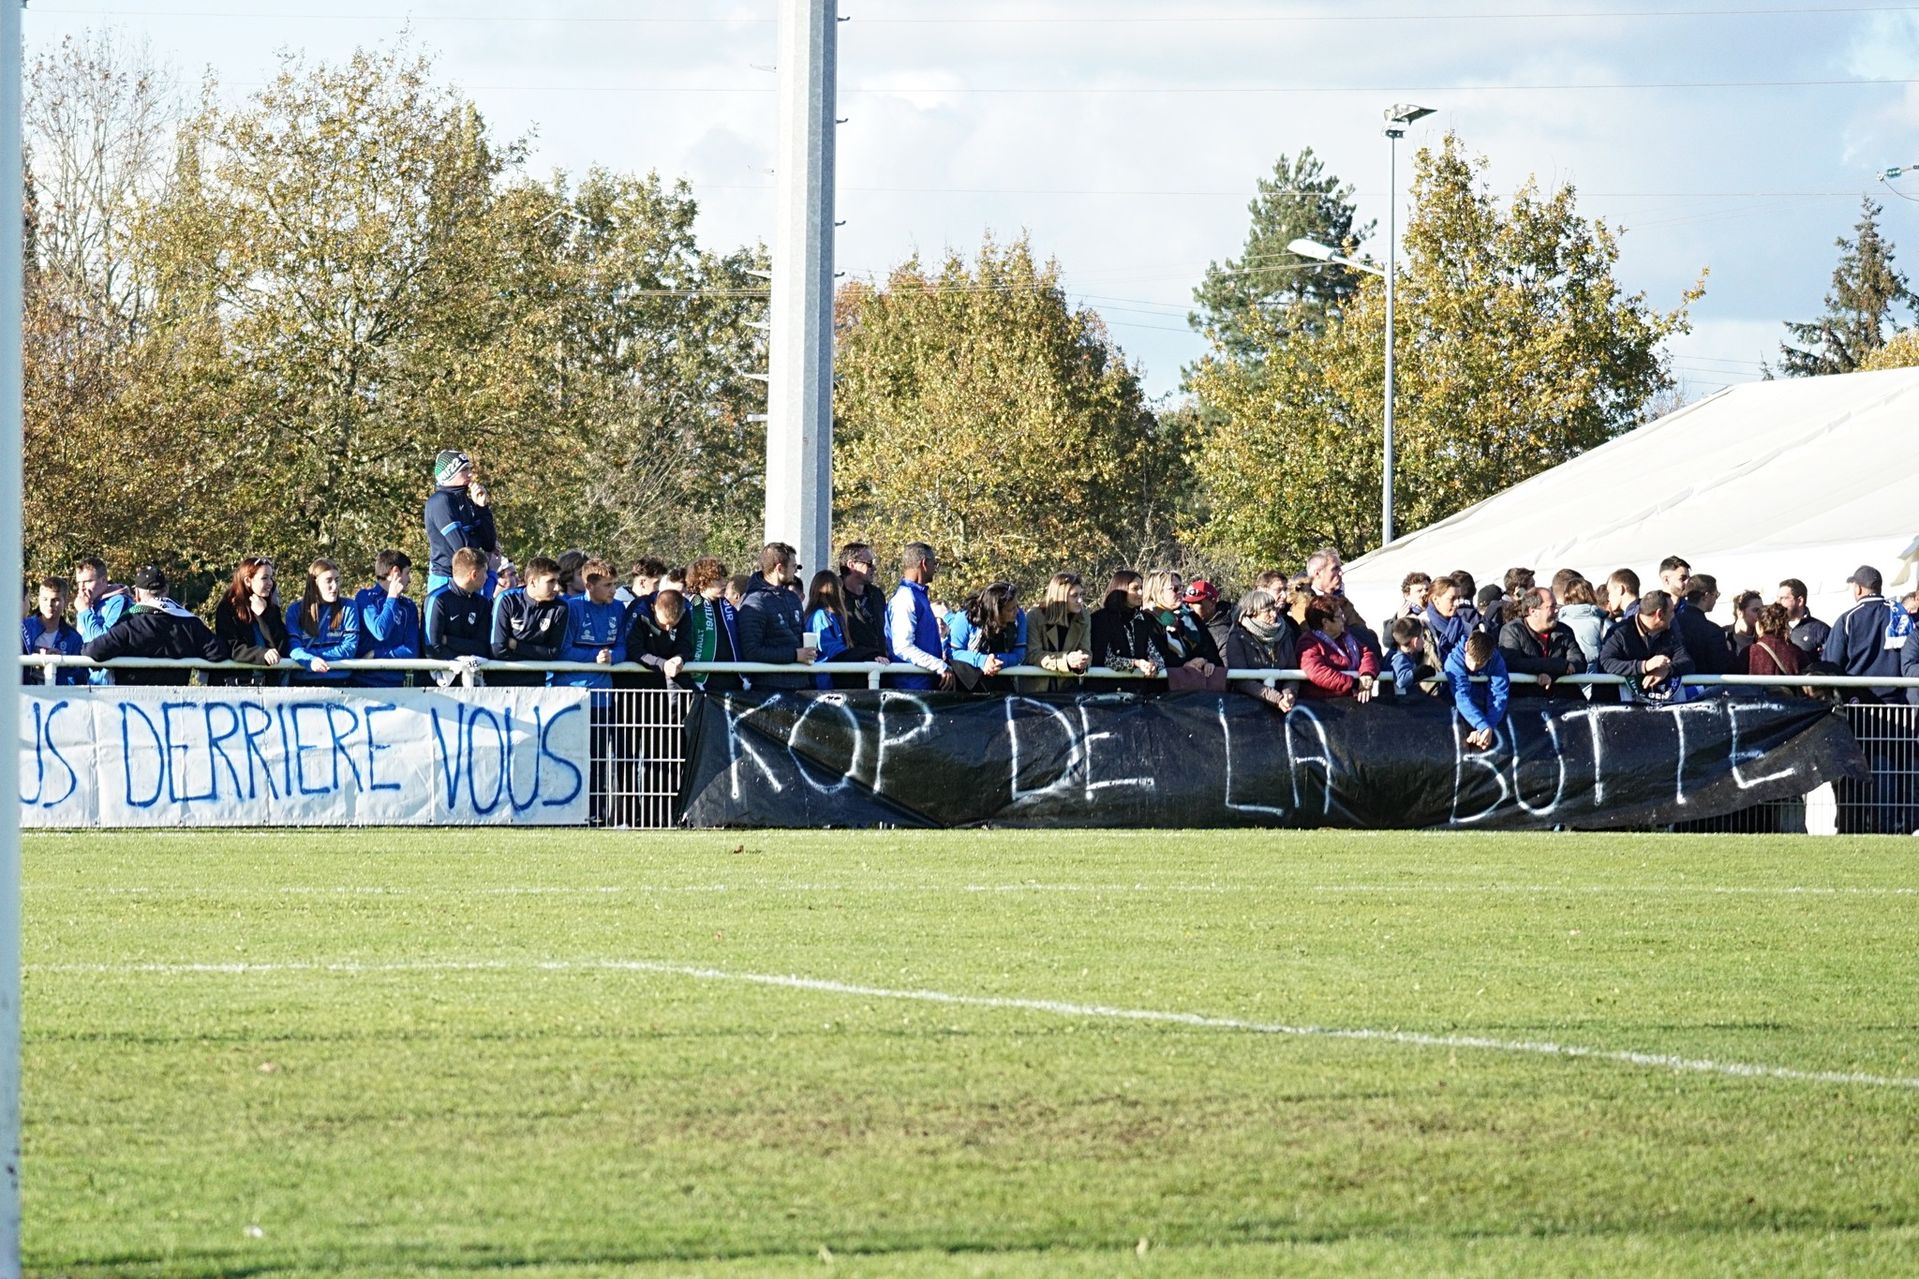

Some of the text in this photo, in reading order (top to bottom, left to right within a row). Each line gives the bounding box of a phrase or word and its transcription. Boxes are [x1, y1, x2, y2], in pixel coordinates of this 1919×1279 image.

[118, 702, 401, 807] DERRIERE
[431, 703, 583, 813] VOUS
[725, 691, 1796, 825] KOP DE LA BUTTE
